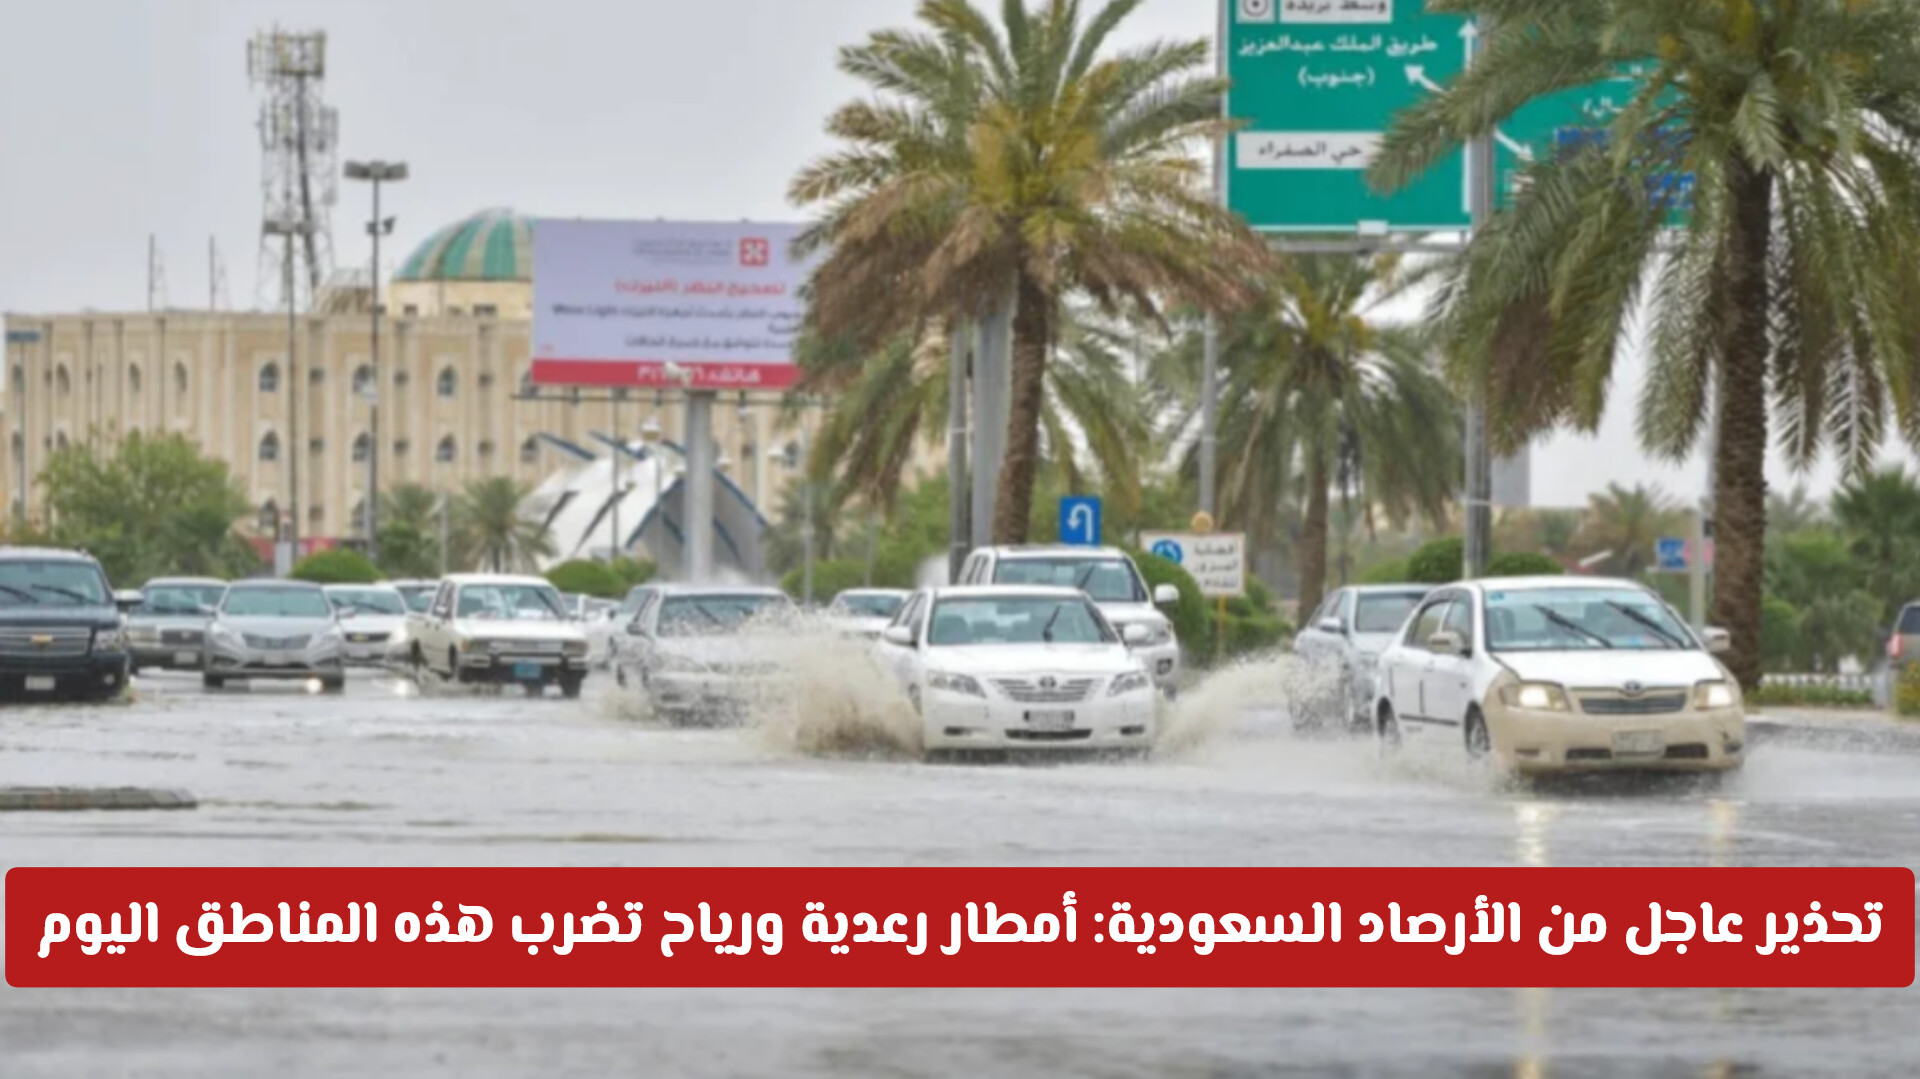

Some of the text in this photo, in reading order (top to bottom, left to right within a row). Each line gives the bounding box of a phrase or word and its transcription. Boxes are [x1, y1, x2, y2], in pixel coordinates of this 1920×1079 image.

[1238, 34, 1438, 57] طريق الملك عبدالعزيز
[1298, 65, 1375, 88] (جنوب)
[1257, 140, 1362, 166] حي الصفراء
